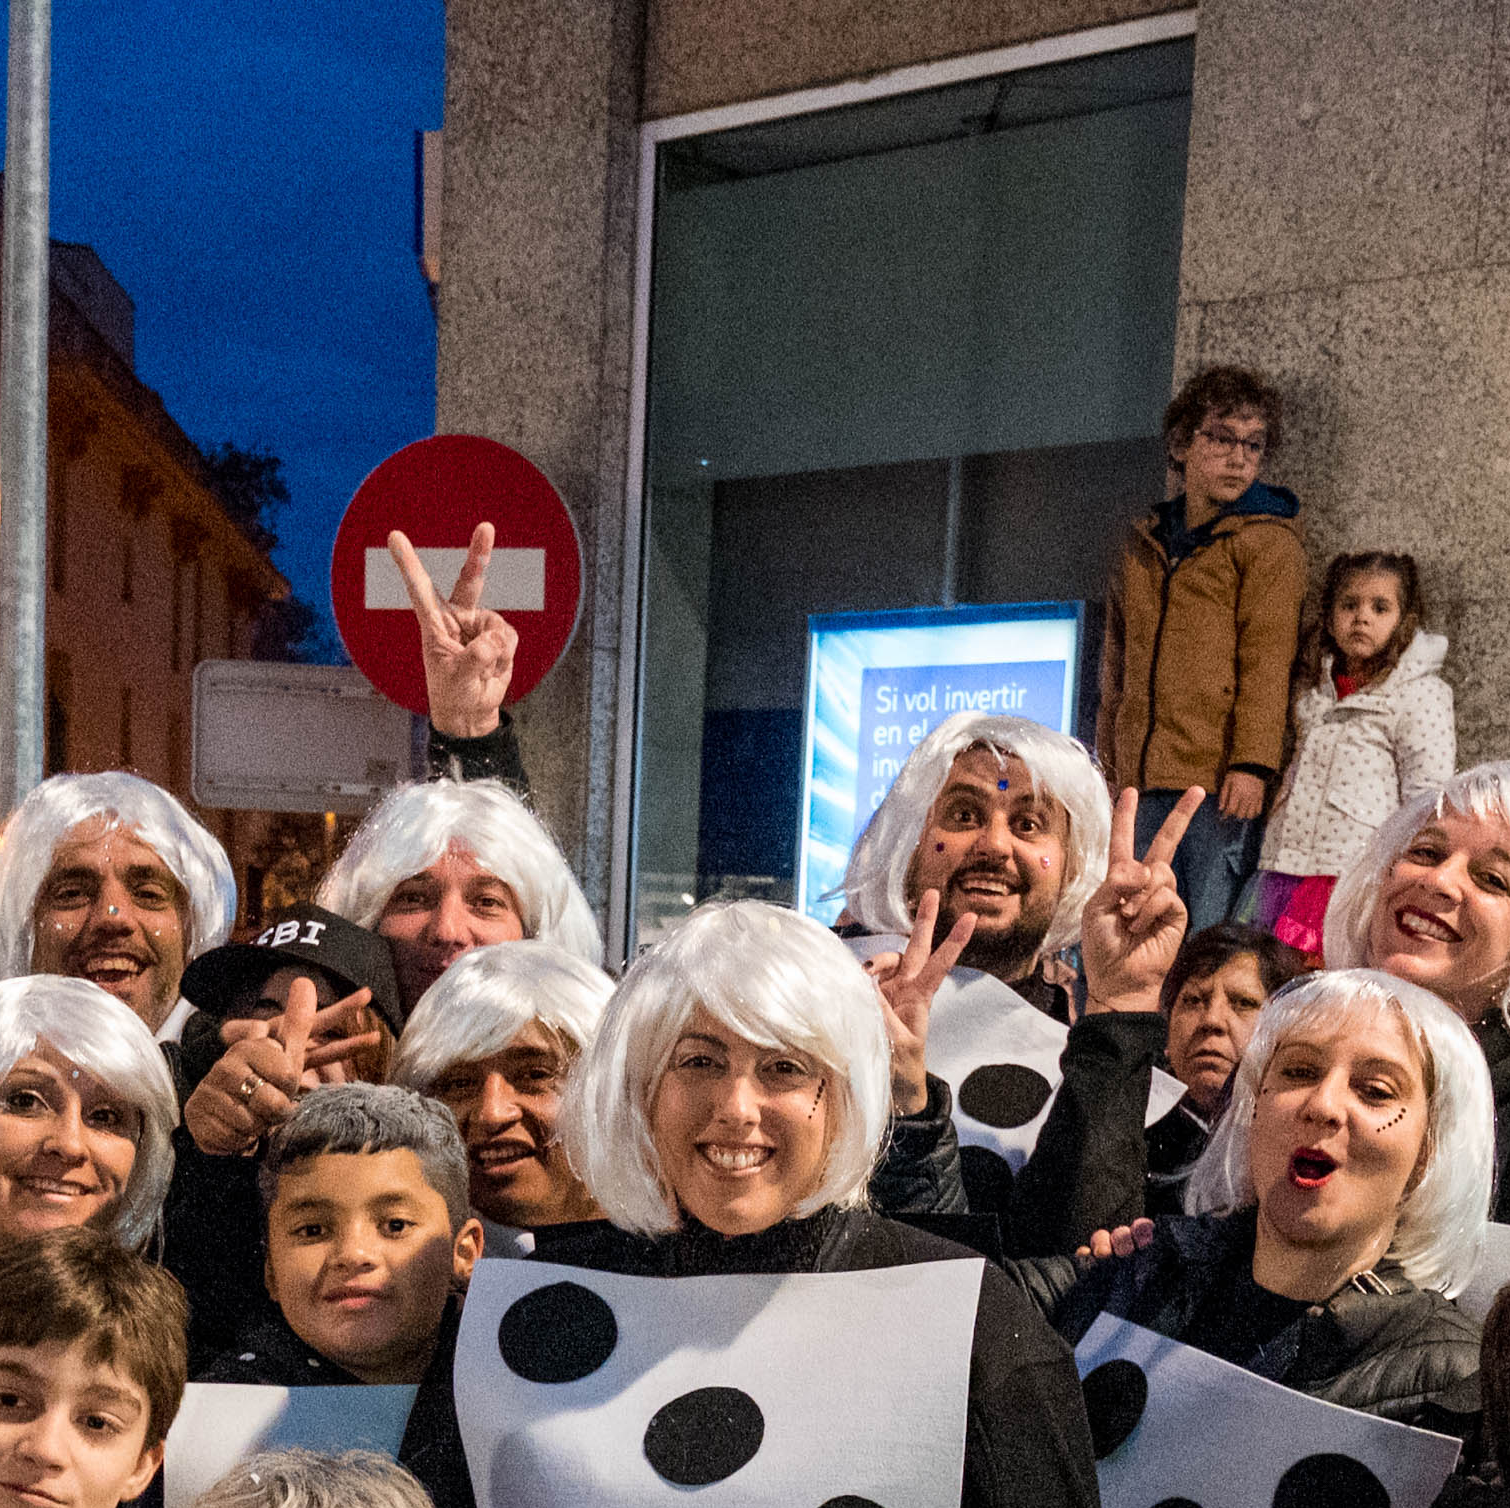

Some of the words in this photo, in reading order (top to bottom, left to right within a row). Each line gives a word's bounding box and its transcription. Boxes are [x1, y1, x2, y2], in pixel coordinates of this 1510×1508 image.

[875, 685, 898, 713] Si
[903, 685, 938, 713] vol
[944, 682, 1027, 711] invertir
[873, 724, 902, 746] en
